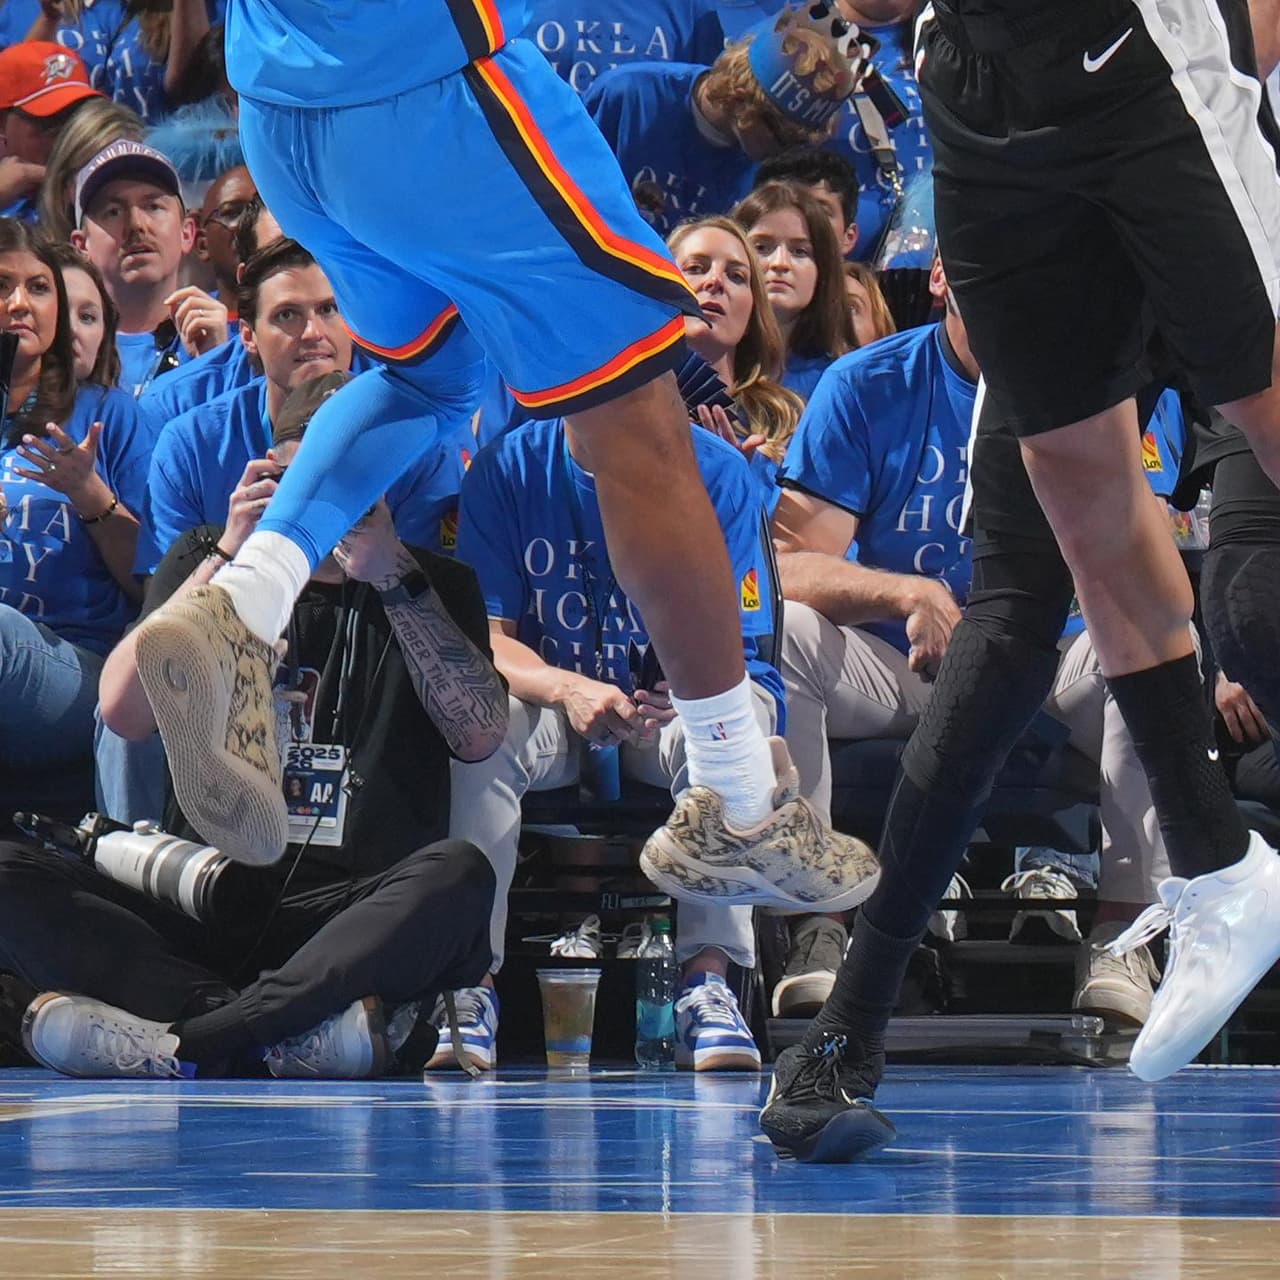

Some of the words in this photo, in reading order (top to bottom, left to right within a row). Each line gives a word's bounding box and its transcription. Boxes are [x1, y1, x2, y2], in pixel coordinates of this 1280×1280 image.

[536, 20, 669, 60] OKLA
[524, 537, 596, 576] OK
[288, 746, 340, 760] 2025
